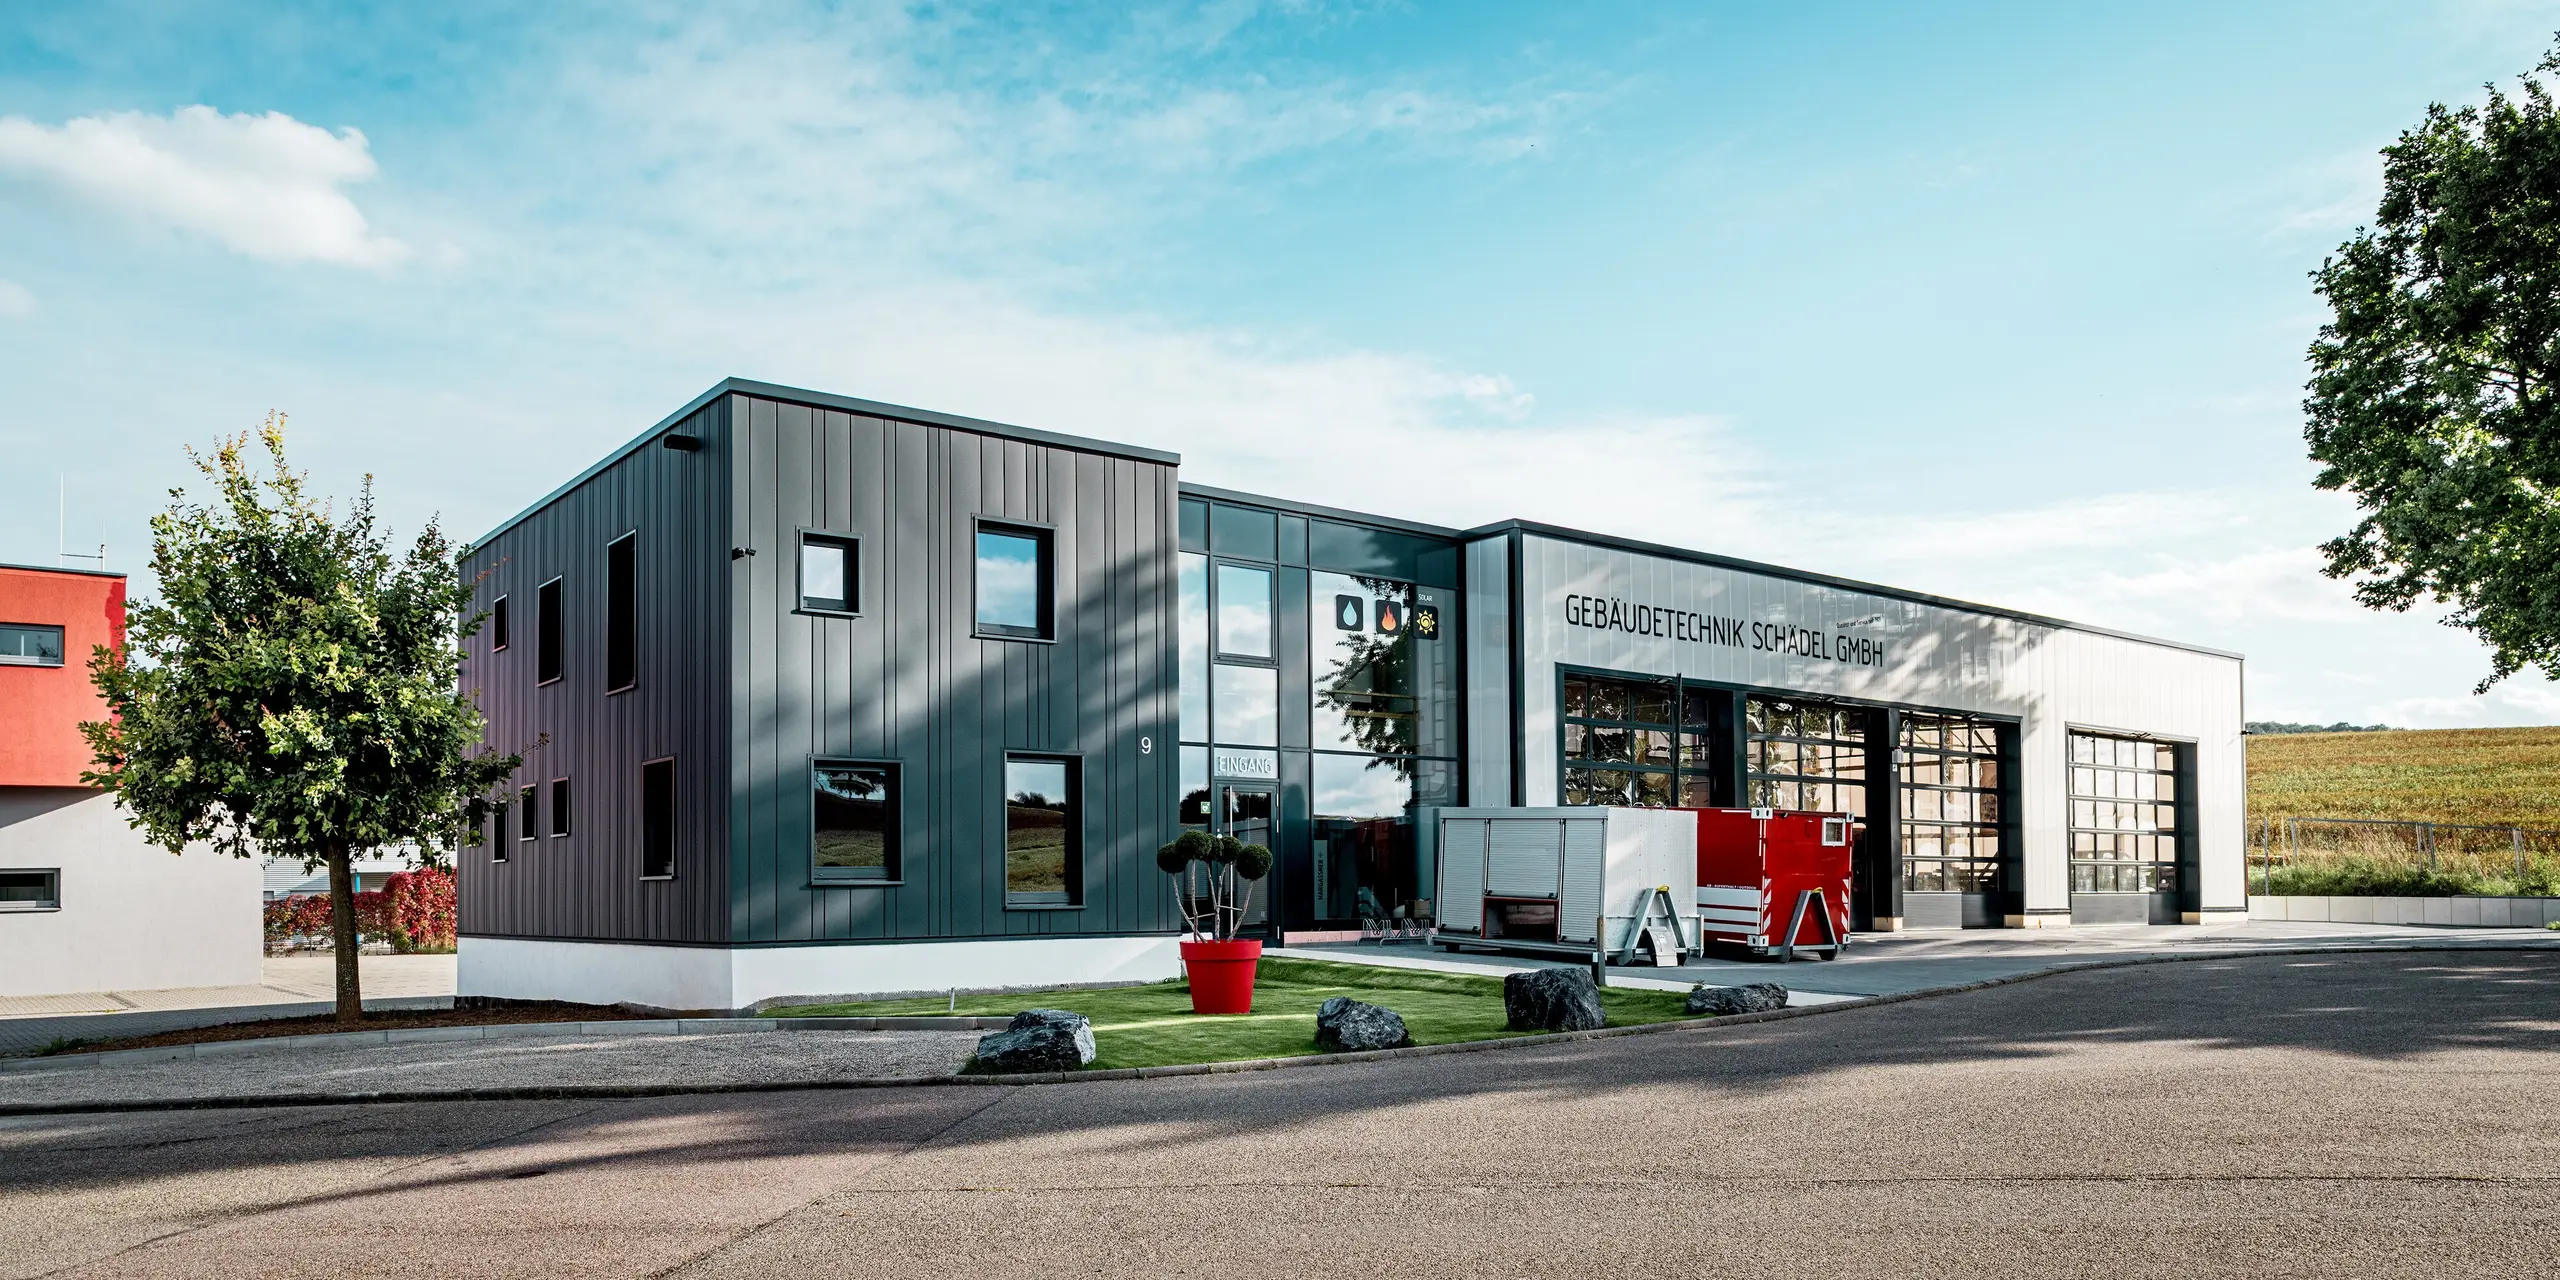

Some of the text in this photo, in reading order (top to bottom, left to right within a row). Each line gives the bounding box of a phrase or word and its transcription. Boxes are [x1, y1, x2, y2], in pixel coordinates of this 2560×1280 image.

[1418, 593, 1433, 602] SOLAR
[1566, 594, 1883, 667] GEBÄUDETECHNIK SCHÄDEL GMBH
[1141, 736, 1152, 754] 9
[1218, 756, 1273, 774] EINGANG
